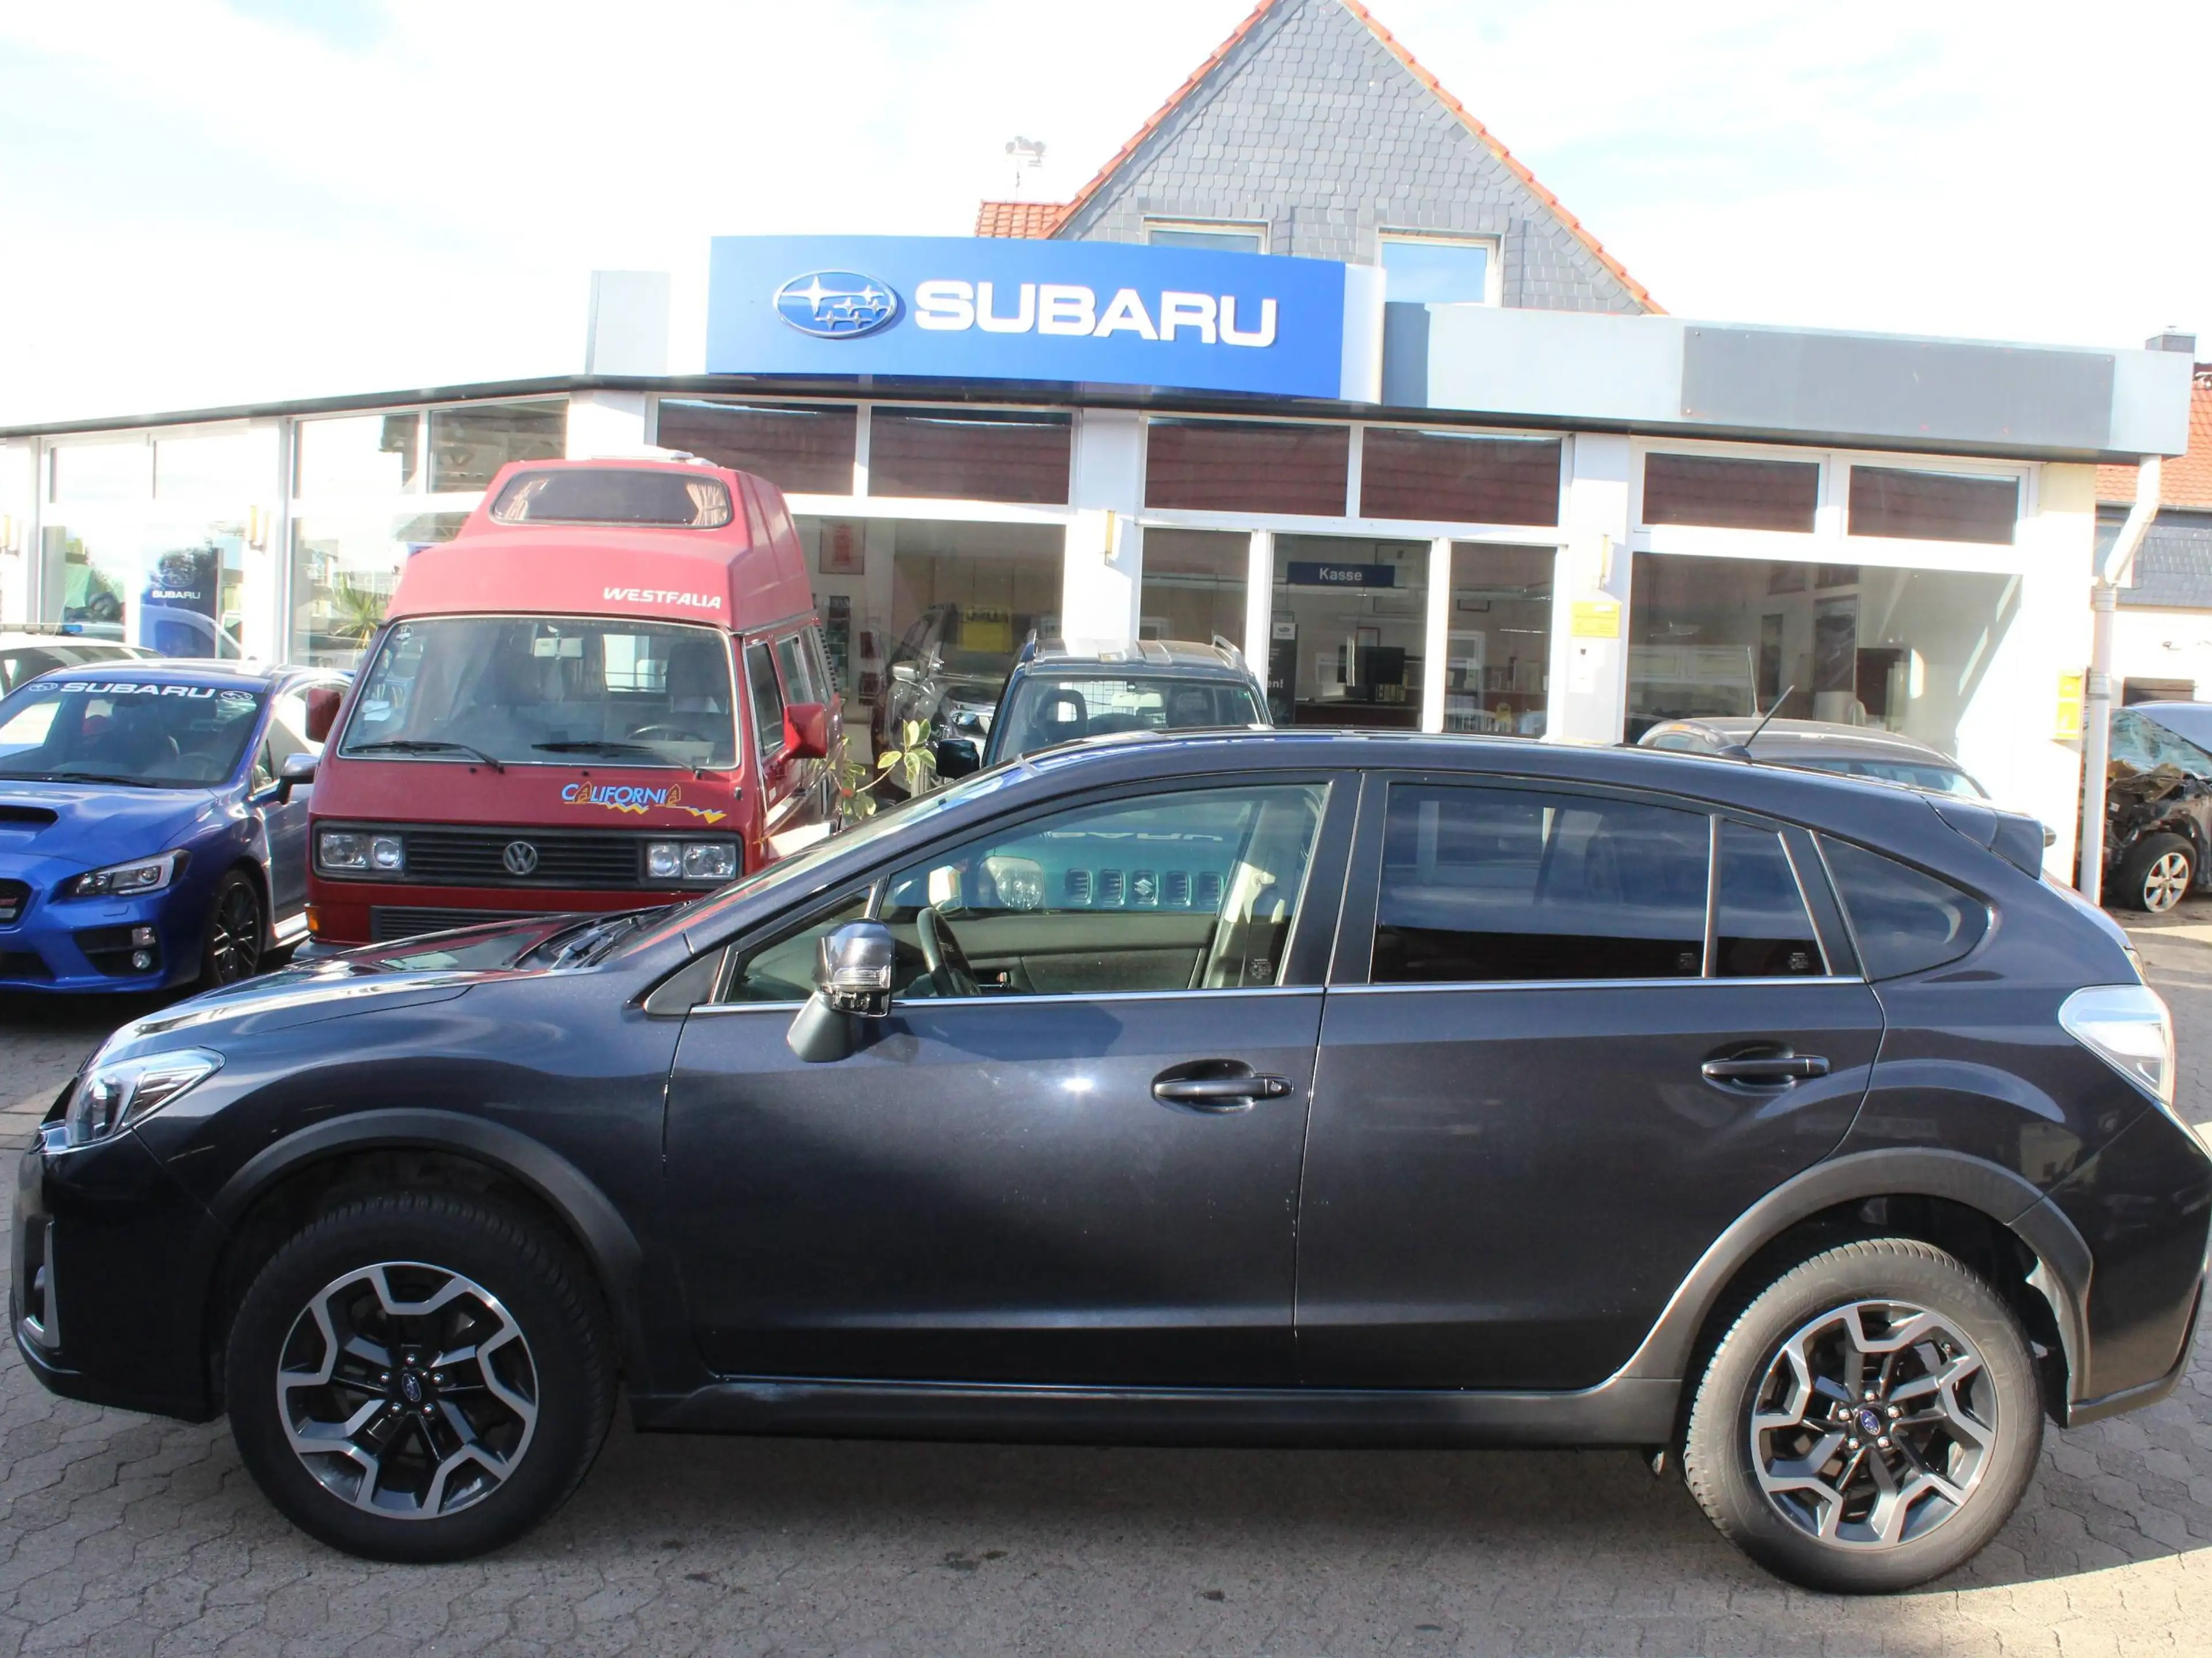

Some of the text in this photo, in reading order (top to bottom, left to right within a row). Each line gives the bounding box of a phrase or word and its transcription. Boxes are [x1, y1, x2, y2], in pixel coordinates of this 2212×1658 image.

[914, 280, 1277, 347] SUBARU
[1319, 568, 1362, 581] Kasse
[152, 590, 201, 599] SUBARU
[603, 587, 722, 609] WESTFALIA
[60, 682, 216, 699] SUBARU
[561, 781, 681, 807] CALIFORNIA
